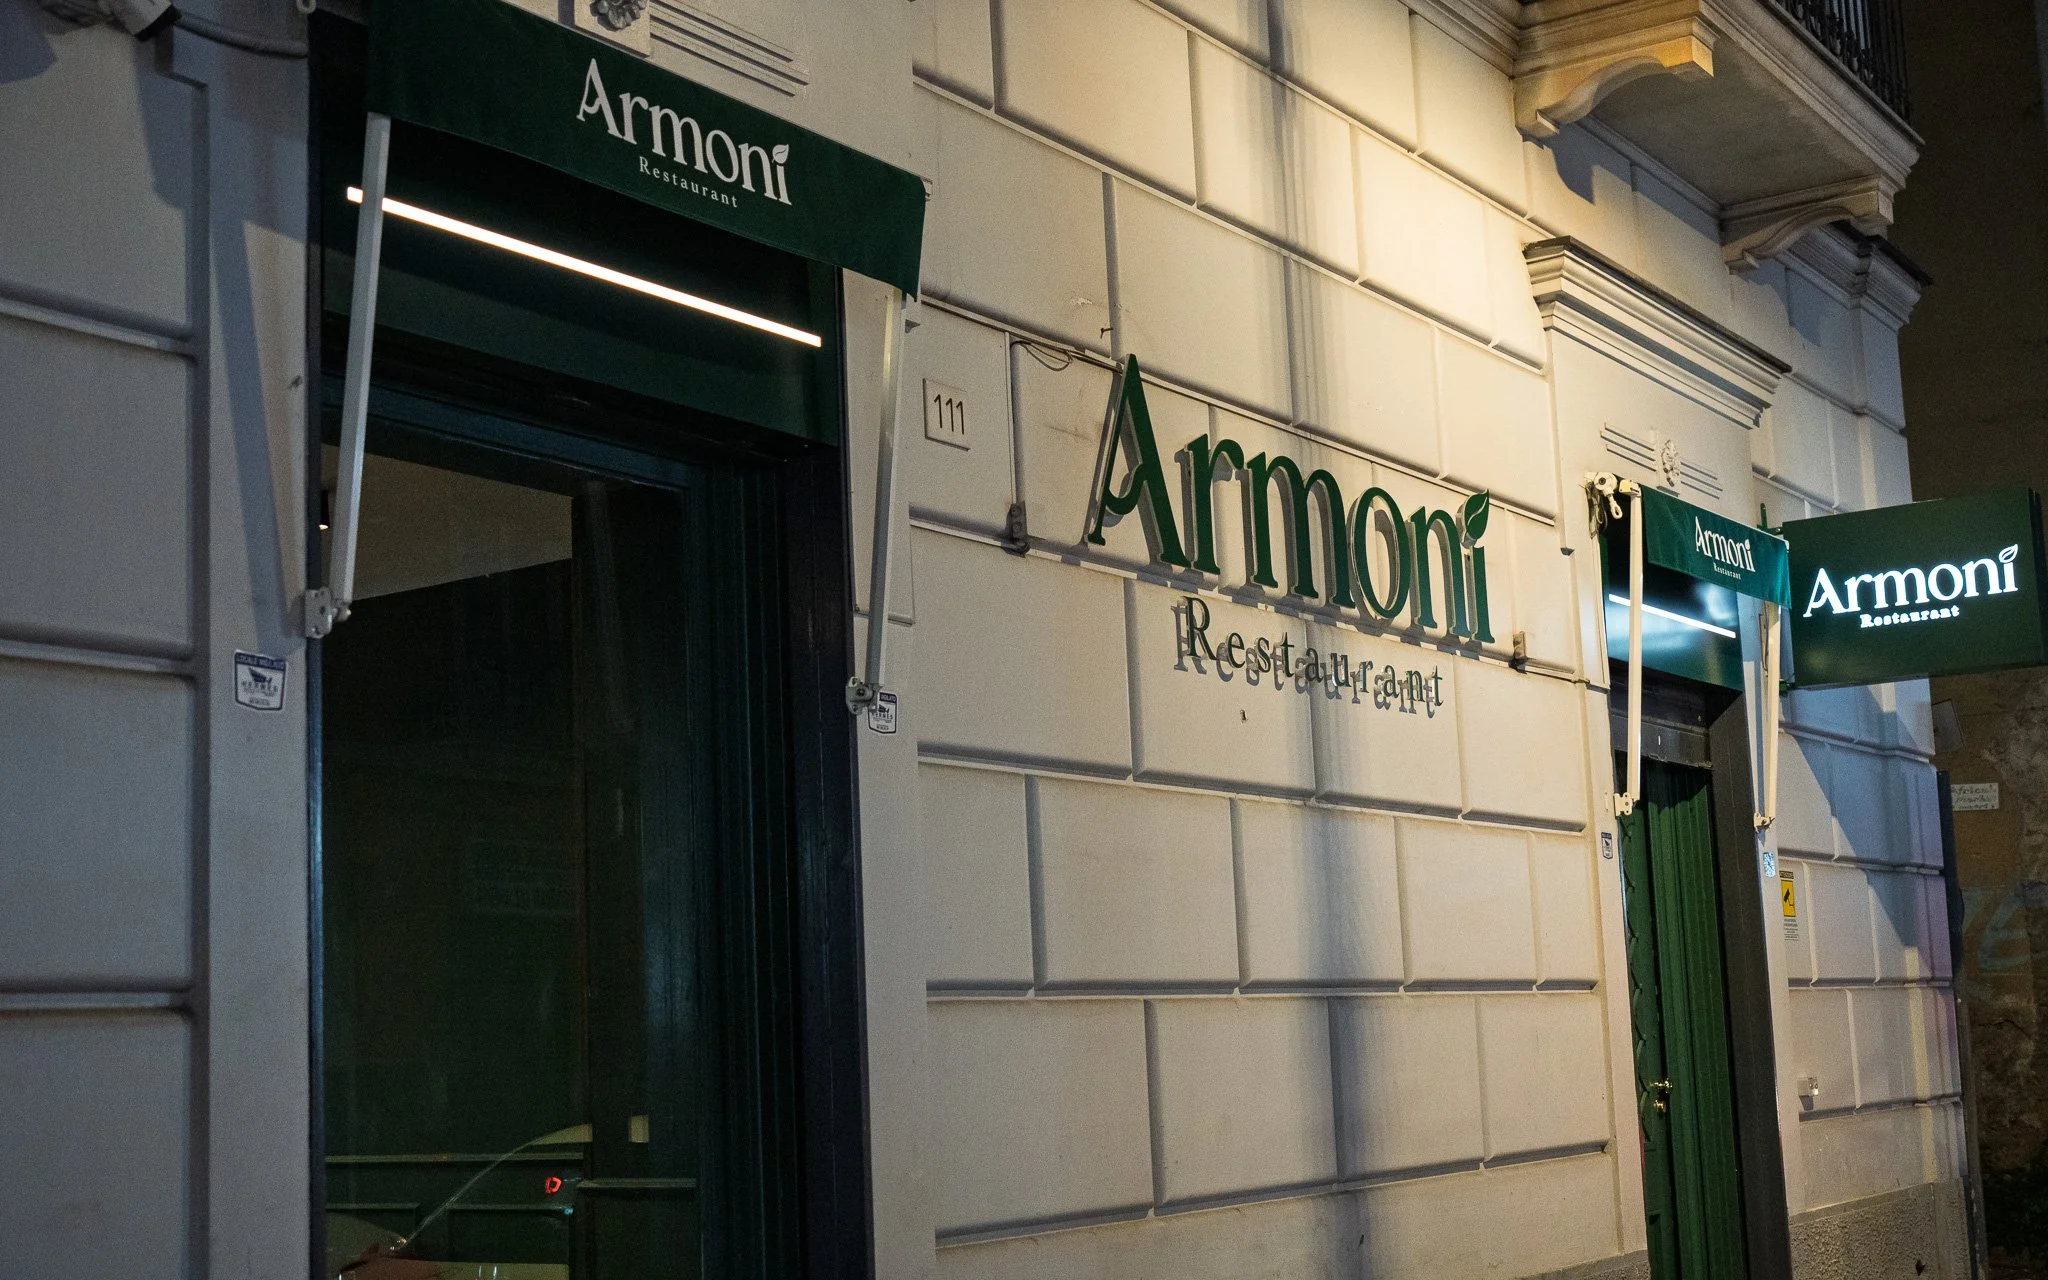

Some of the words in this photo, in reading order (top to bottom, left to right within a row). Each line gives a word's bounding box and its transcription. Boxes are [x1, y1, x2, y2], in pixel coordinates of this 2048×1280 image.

[576, 58, 792, 205] Armoni
[639, 156, 738, 208] Restaurant
[934, 393, 965, 435] 111
[1088, 353, 1495, 644] Armoni
[1695, 515, 1756, 573] Armoni
[1803, 544, 2019, 618] Armoni
[1860, 604, 1960, 628] Restaurant
[1184, 596, 1445, 708] Restaurant
